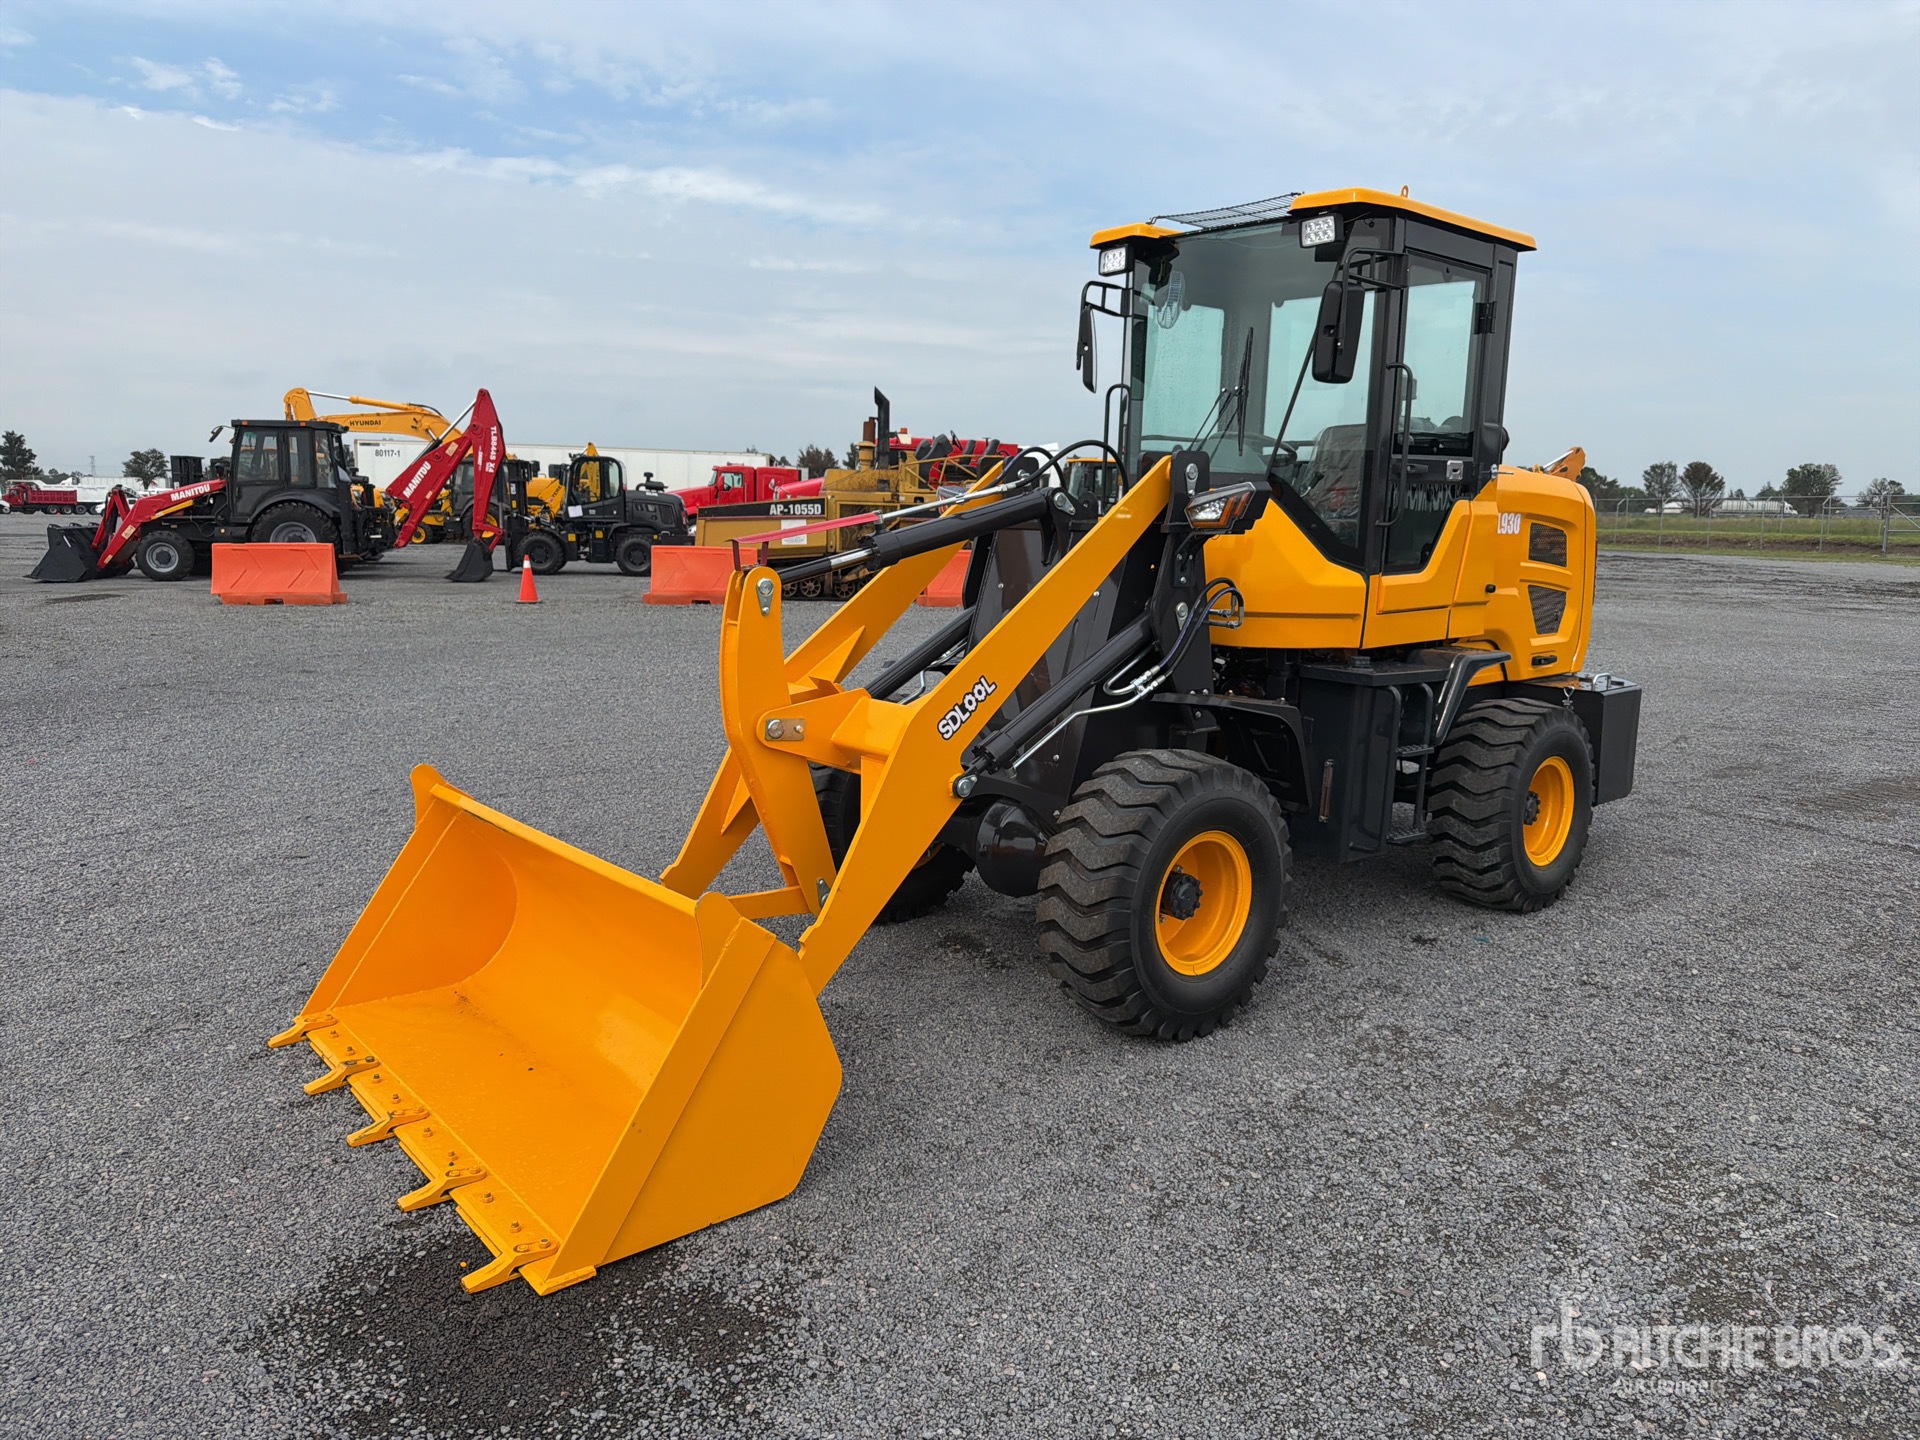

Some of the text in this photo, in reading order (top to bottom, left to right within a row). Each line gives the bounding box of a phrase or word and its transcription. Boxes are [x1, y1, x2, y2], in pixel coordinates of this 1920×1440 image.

[374, 449, 401, 458] 80117-1
[402, 460, 432, 499] MANITOU
[170, 483, 211, 502] MANITOU
[769, 503, 822, 516] AP-1055D
[1497, 512, 1521, 535] L930
[937, 675, 998, 741] SDLOOL
